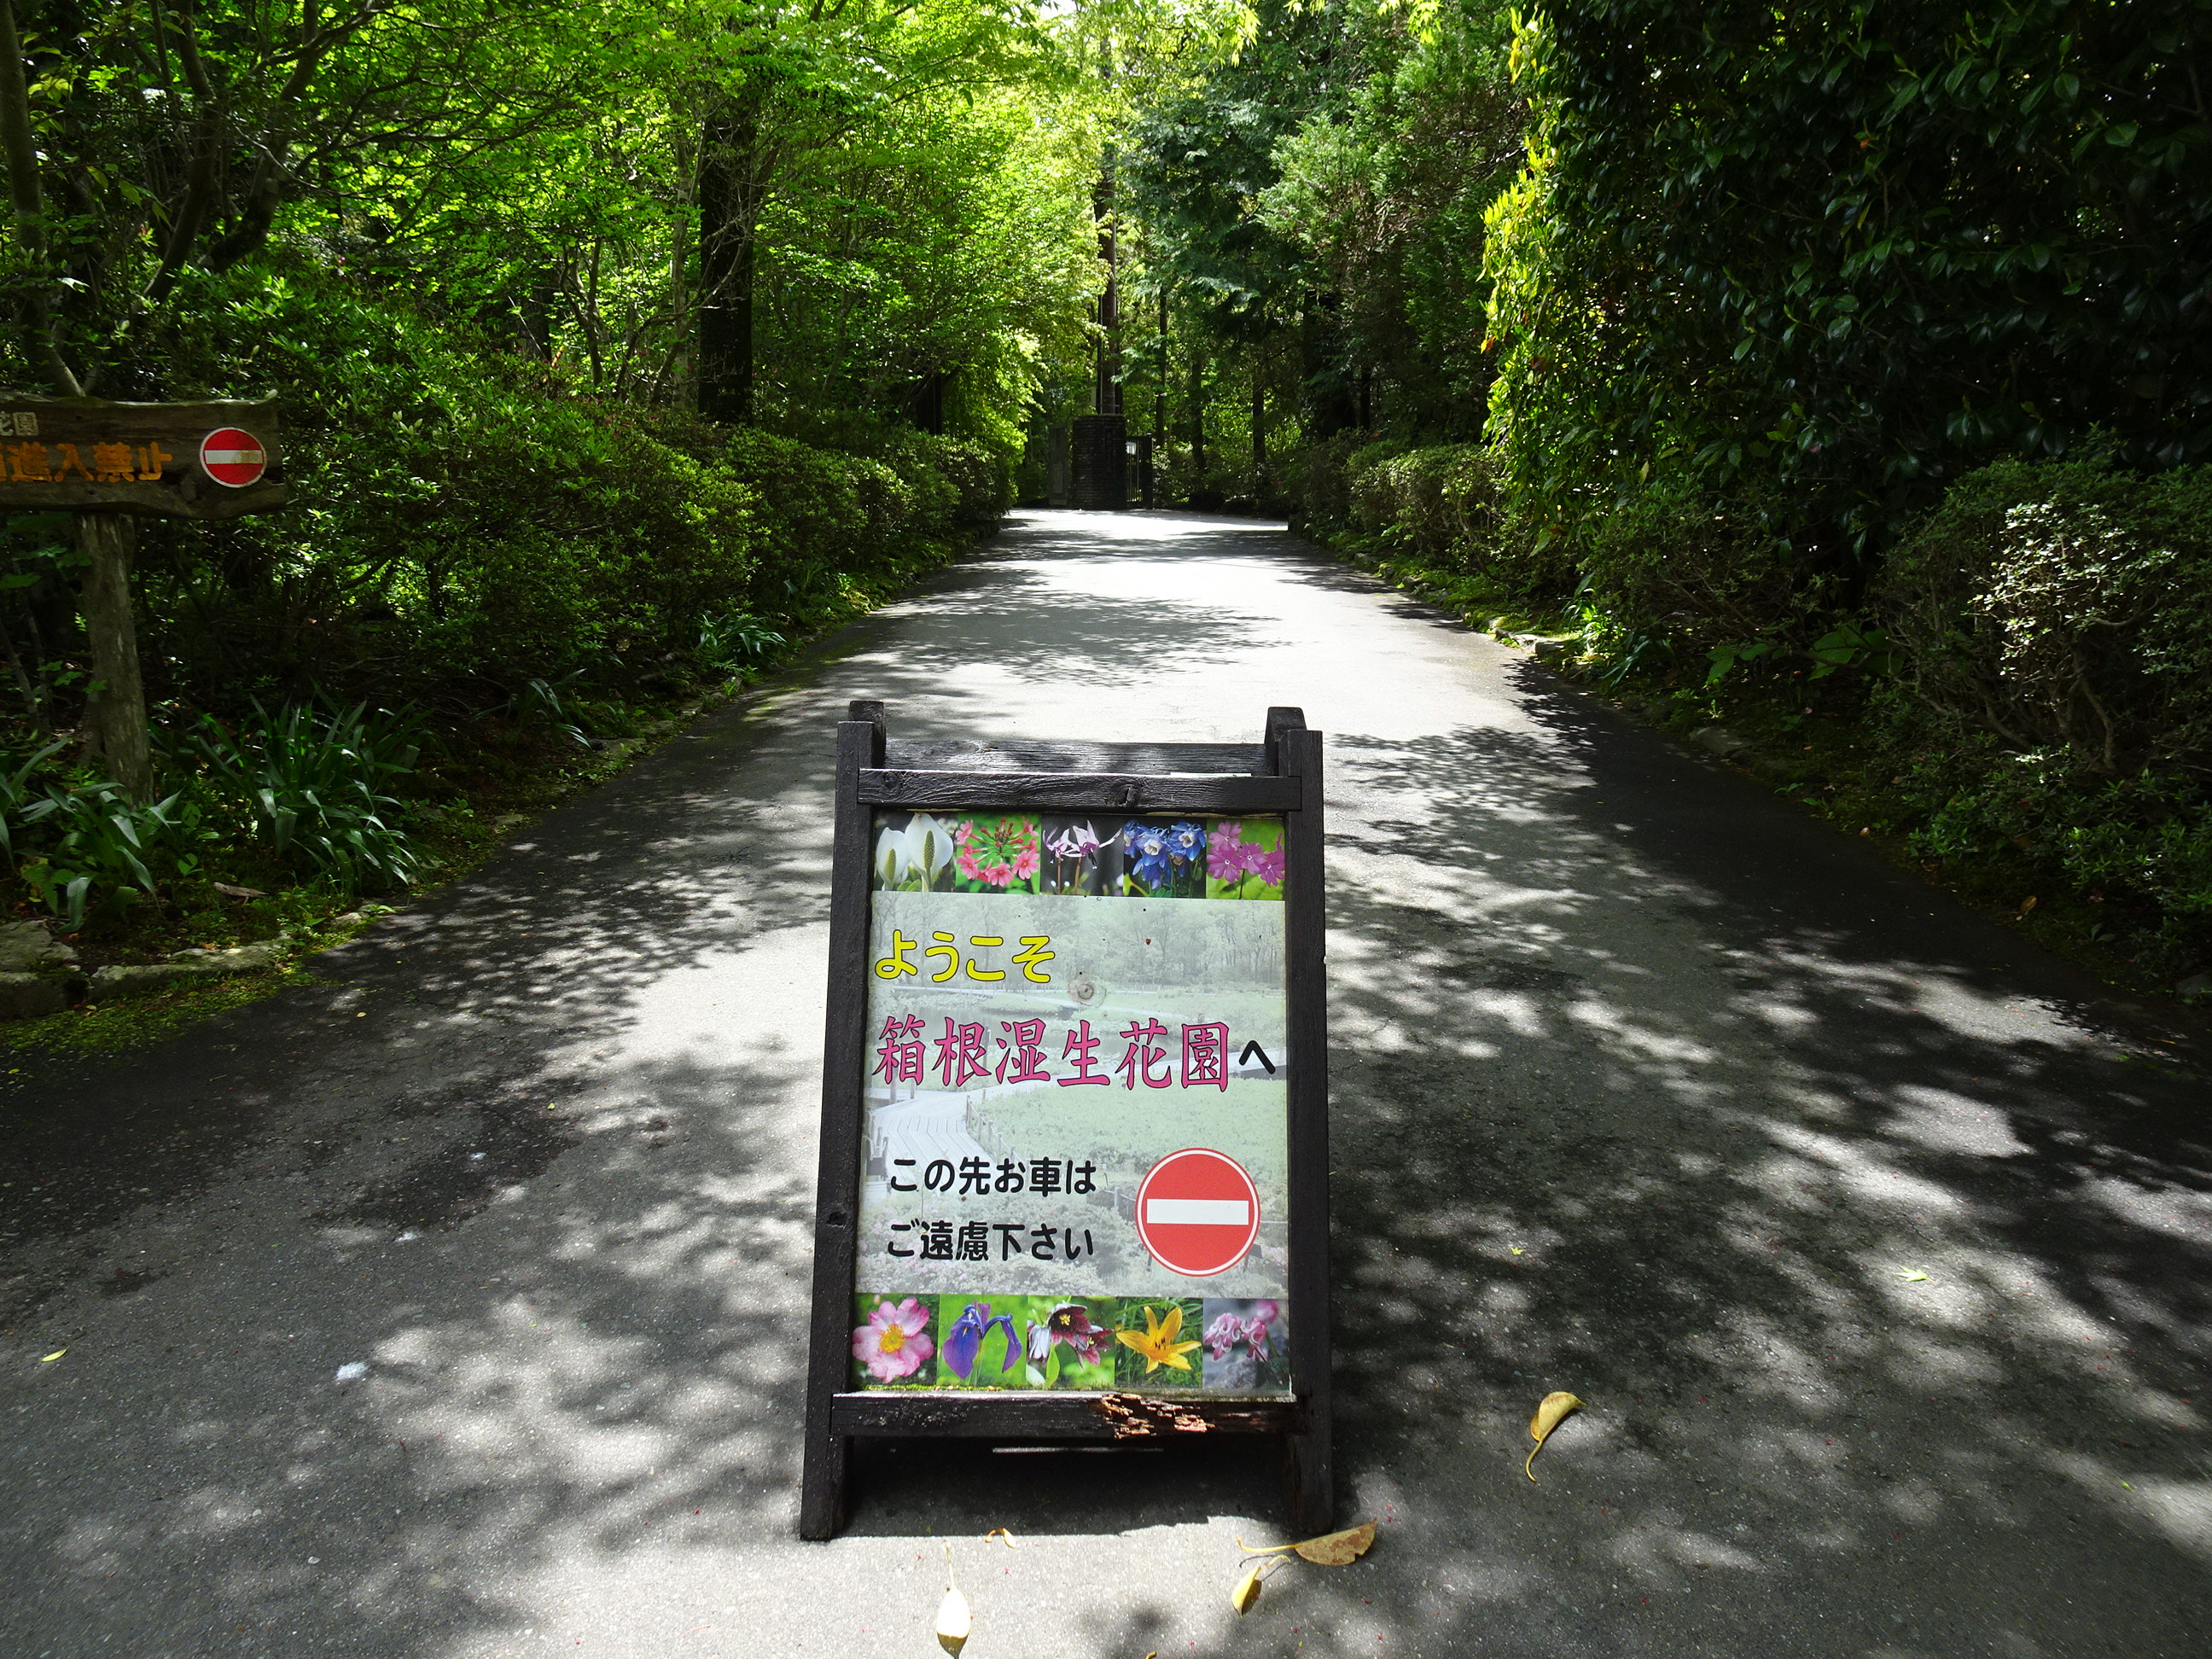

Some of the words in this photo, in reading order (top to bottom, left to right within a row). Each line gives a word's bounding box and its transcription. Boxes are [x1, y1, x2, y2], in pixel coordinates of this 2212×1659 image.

[0, 440, 173, 482] 進入禁止
[874, 928, 1056, 983] ようこそ
[871, 1013, 1277, 1092] 箱根湿生花園へ
[889, 1156, 1096, 1197] この先お車は
[888, 1219, 1094, 1261] ご遠慮下さい
